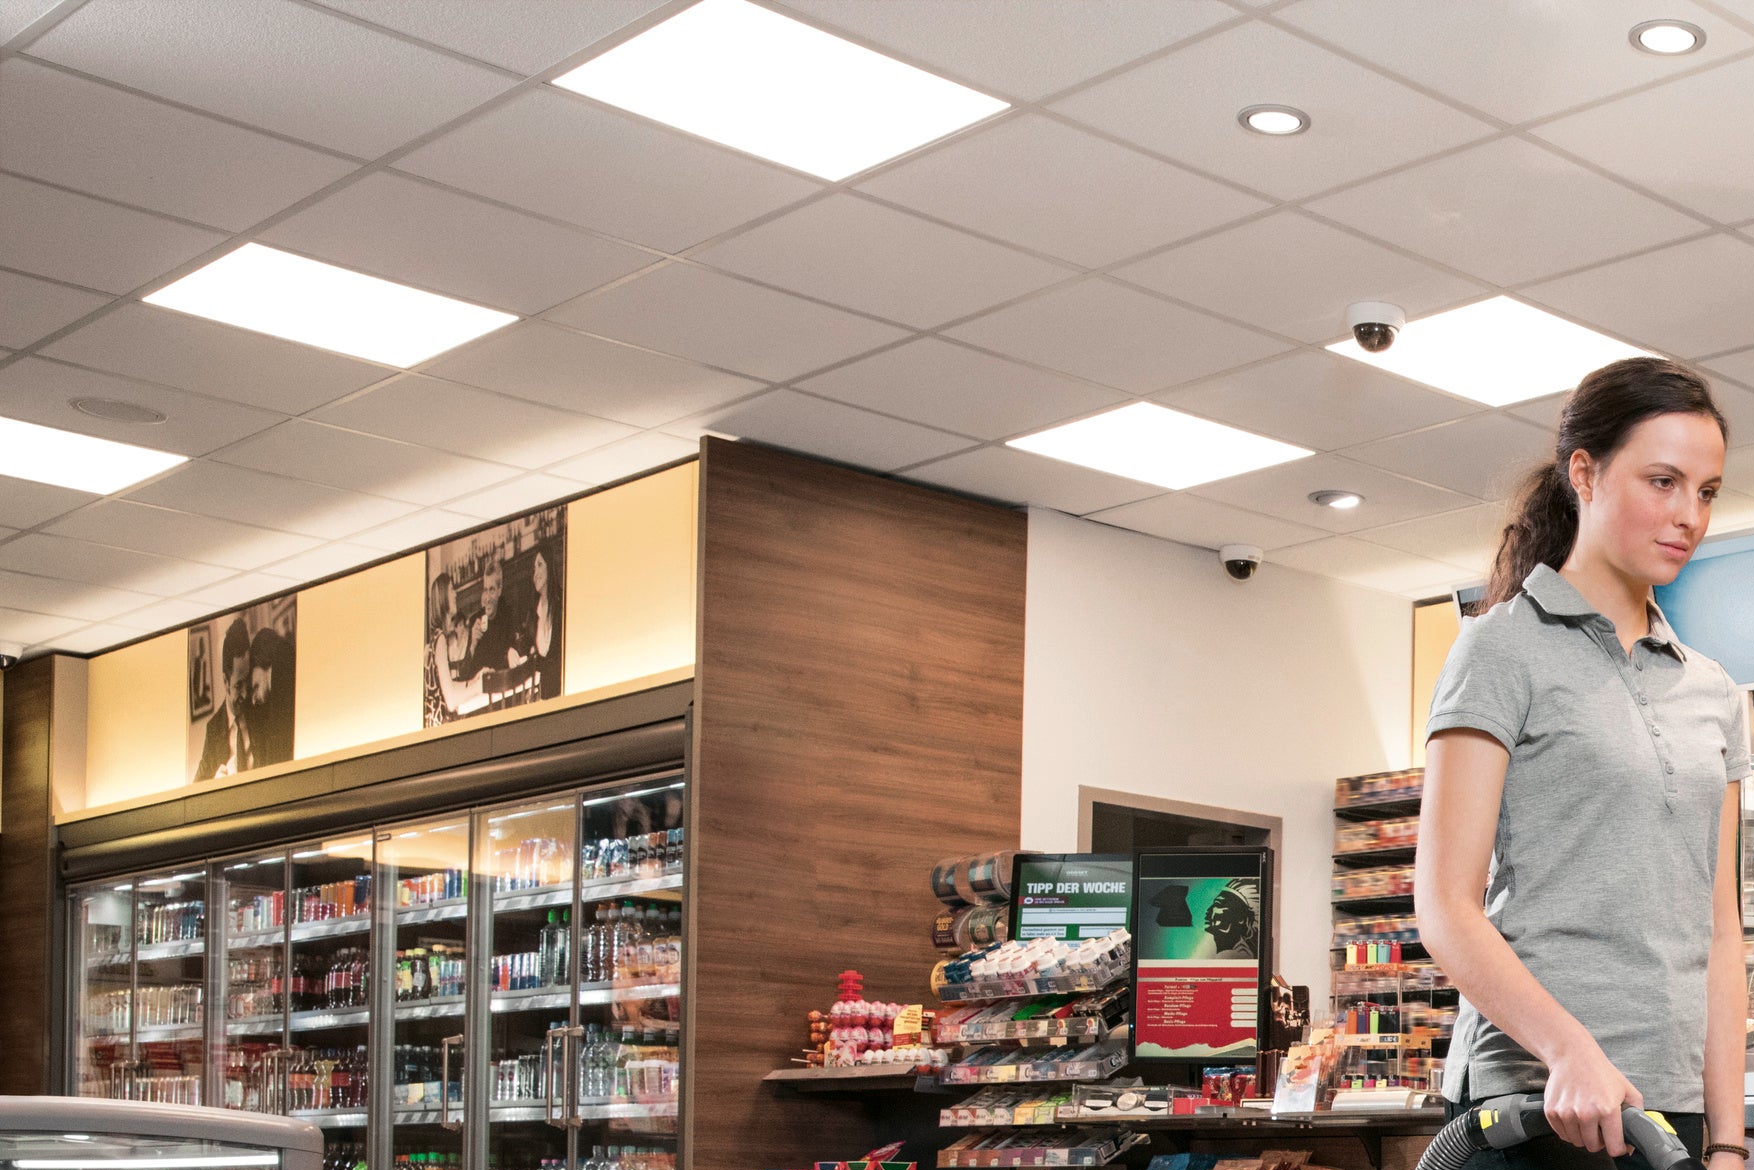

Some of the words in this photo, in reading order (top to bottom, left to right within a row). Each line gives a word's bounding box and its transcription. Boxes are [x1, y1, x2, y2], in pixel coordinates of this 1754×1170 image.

[1027, 882, 1053, 894] TIPP
[1056, 882, 1080, 894] DER
[1083, 881, 1126, 893] WOCHE
